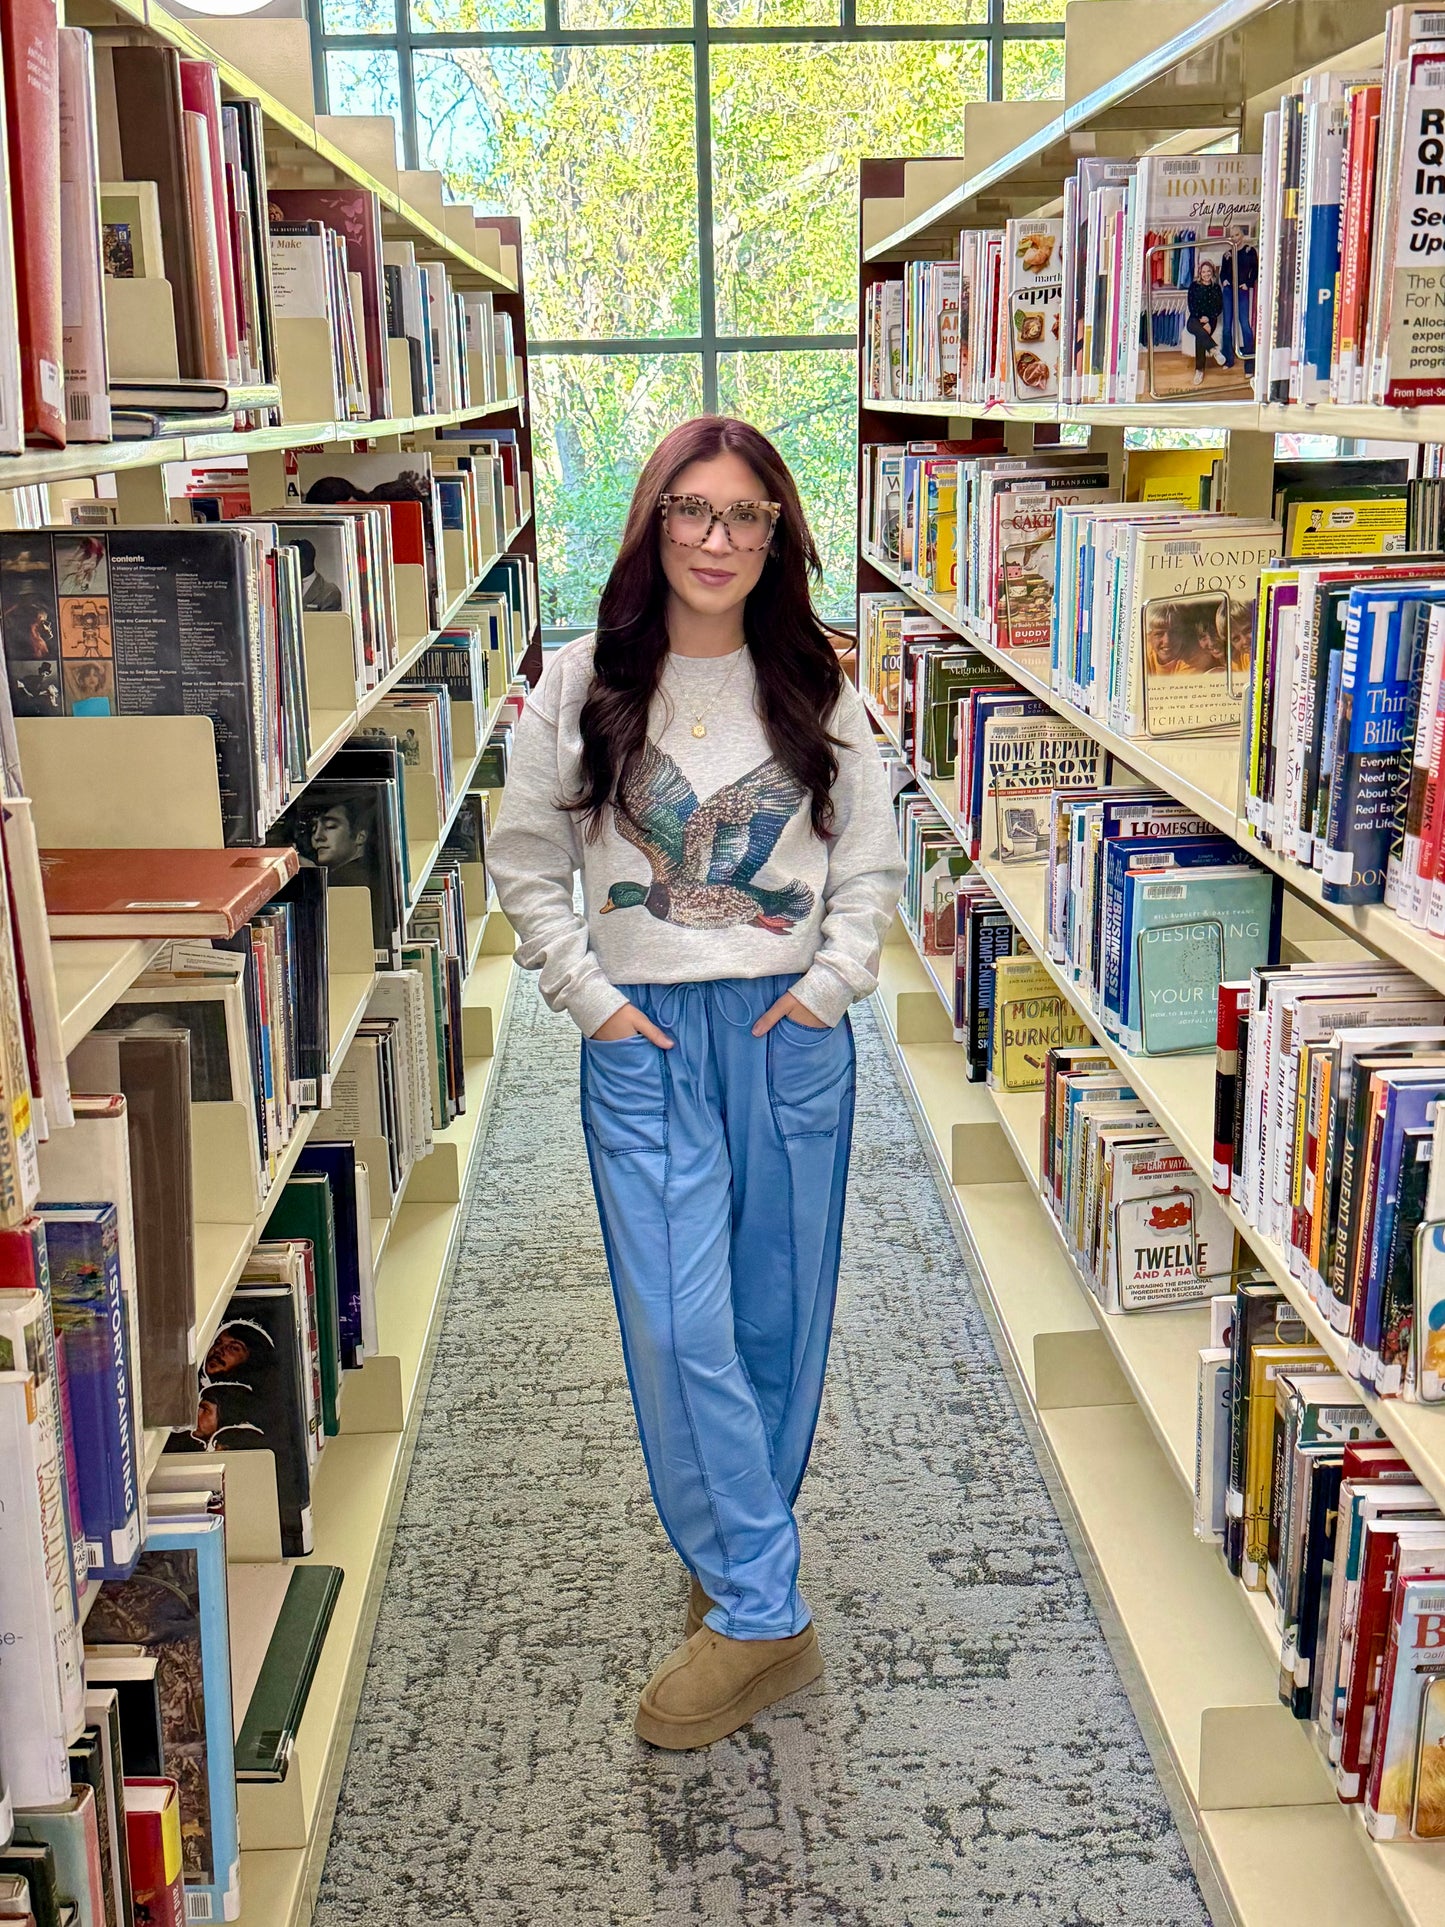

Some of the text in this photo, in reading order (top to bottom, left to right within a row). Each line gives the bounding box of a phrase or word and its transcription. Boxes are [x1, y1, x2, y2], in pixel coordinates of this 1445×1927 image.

[1214, 161, 1244, 174] THE
[1168, 178, 1232, 197] HOME
[277, 240, 302, 248] Make
[1408, 274, 1435, 289] The
[1406, 293, 1430, 308] For
[1394, 388, 1414, 398] From
[1148, 555, 1183, 569] THE
[1175, 575, 1246, 594] of BOYS
[1414, 602, 1428, 662] Jack
[1429, 620, 1438, 643] The
[1343, 606, 1362, 689] TRUMP
[427, 652, 469, 677] EARL JONES
[950, 665, 990, 676] Magnolia
[1301, 653, 1309, 684] DELIVER
[1304, 594, 1323, 754] OVERCOMING IMPOSSIBLE
[1419, 652, 1435, 718] Real-Life
[1298, 695, 1306, 722] TED
[989, 740, 1100, 762] HOME REPAIR
[989, 759, 1097, 777] WISDOM
[1335, 755, 1345, 782] Think
[1359, 773, 1382, 783] Need
[1423, 715, 1443, 831] WINNING WORKS
[1332, 785, 1342, 806] Like
[1357, 788, 1387, 798] About
[1356, 805, 1377, 814] Real
[1354, 820, 1393, 830] and Life
[1146, 922, 1260, 944] DESIGNING
[1109, 902, 1122, 989] BUSINESS
[978, 928, 994, 1008] COMPENDIUM
[1150, 987, 1203, 1004] YOUR
[1004, 1024, 1087, 1046] BURNOUT
[1236, 1048, 1244, 1078] Admiral
[1235, 1081, 1243, 1109] William
[1327, 1097, 1336, 1150] HOW
[1147, 1160, 1168, 1171] GARY
[1325, 1157, 1333, 1184] TO
[1334, 1137, 1354, 1295] ANCIENT BREWS
[1134, 1243, 1208, 1270] TWELVE
[1133, 1266, 1207, 1279] AND A HAF
[109, 1275, 133, 1512] STORY PAINTING
[37, 1464, 52, 1580] LANDSCAPES
[43, 1454, 72, 1614] PAINTING
